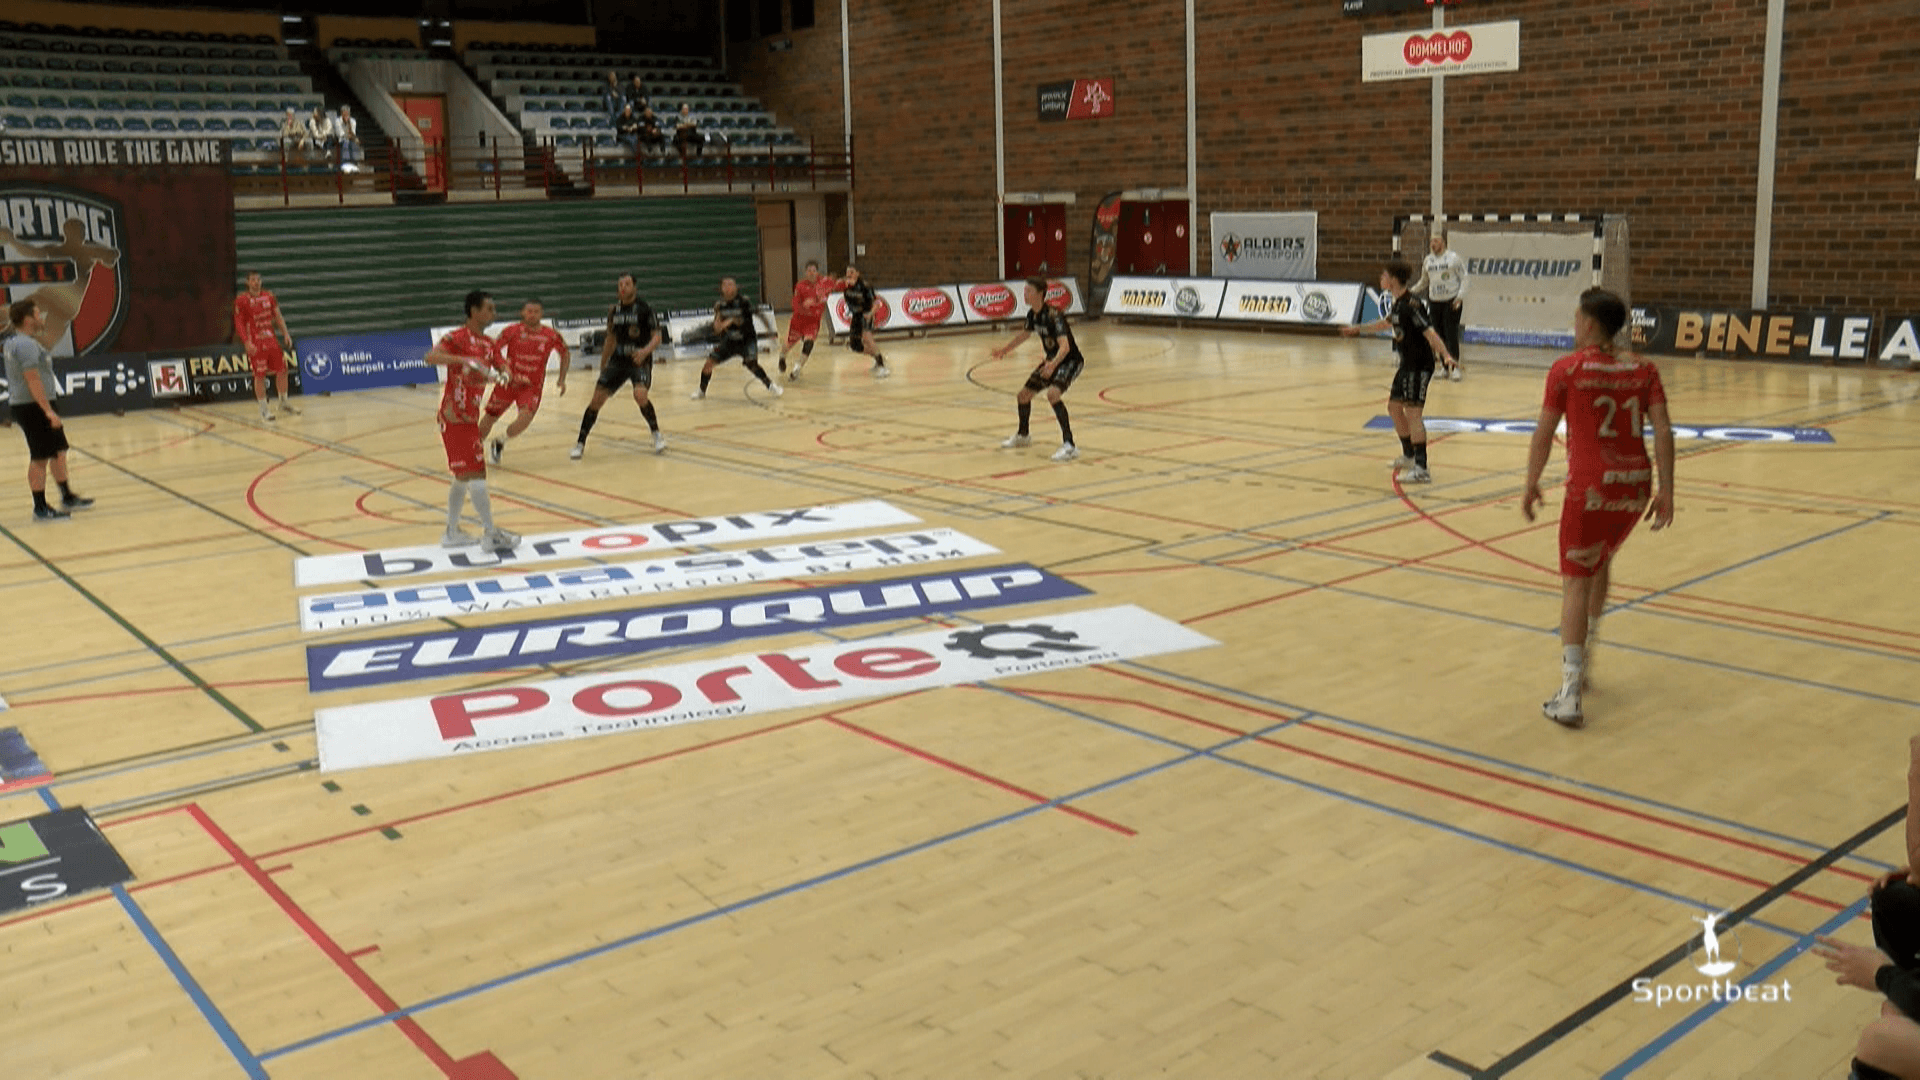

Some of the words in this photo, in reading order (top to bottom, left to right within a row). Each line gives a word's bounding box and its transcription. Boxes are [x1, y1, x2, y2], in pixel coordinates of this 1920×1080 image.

[1409, 38, 1467, 58] DOMMELHOF
[63, 140, 118, 164] RULE
[123, 140, 162, 164] THE
[166, 140, 220, 164] GAME
[1243, 237, 1305, 250] ALDERS
[1244, 250, 1305, 260] TRANSPORT
[1, 264, 65, 282] PELT
[1467, 257, 1581, 279] EUROQUIP
[342, 361, 384, 376] Neerpelt
[1593, 395, 1642, 438] 21
[362, 508, 832, 576] buropix
[317, 610, 431, 629] 100%
[457, 570, 766, 613] WATERPROOF
[805, 559, 853, 575] BY
[877, 548, 965, 566] HDM
[322, 568, 1043, 678] EUROQUIP
[453, 729, 565, 752] Access
[573, 703, 748, 735] Technology
